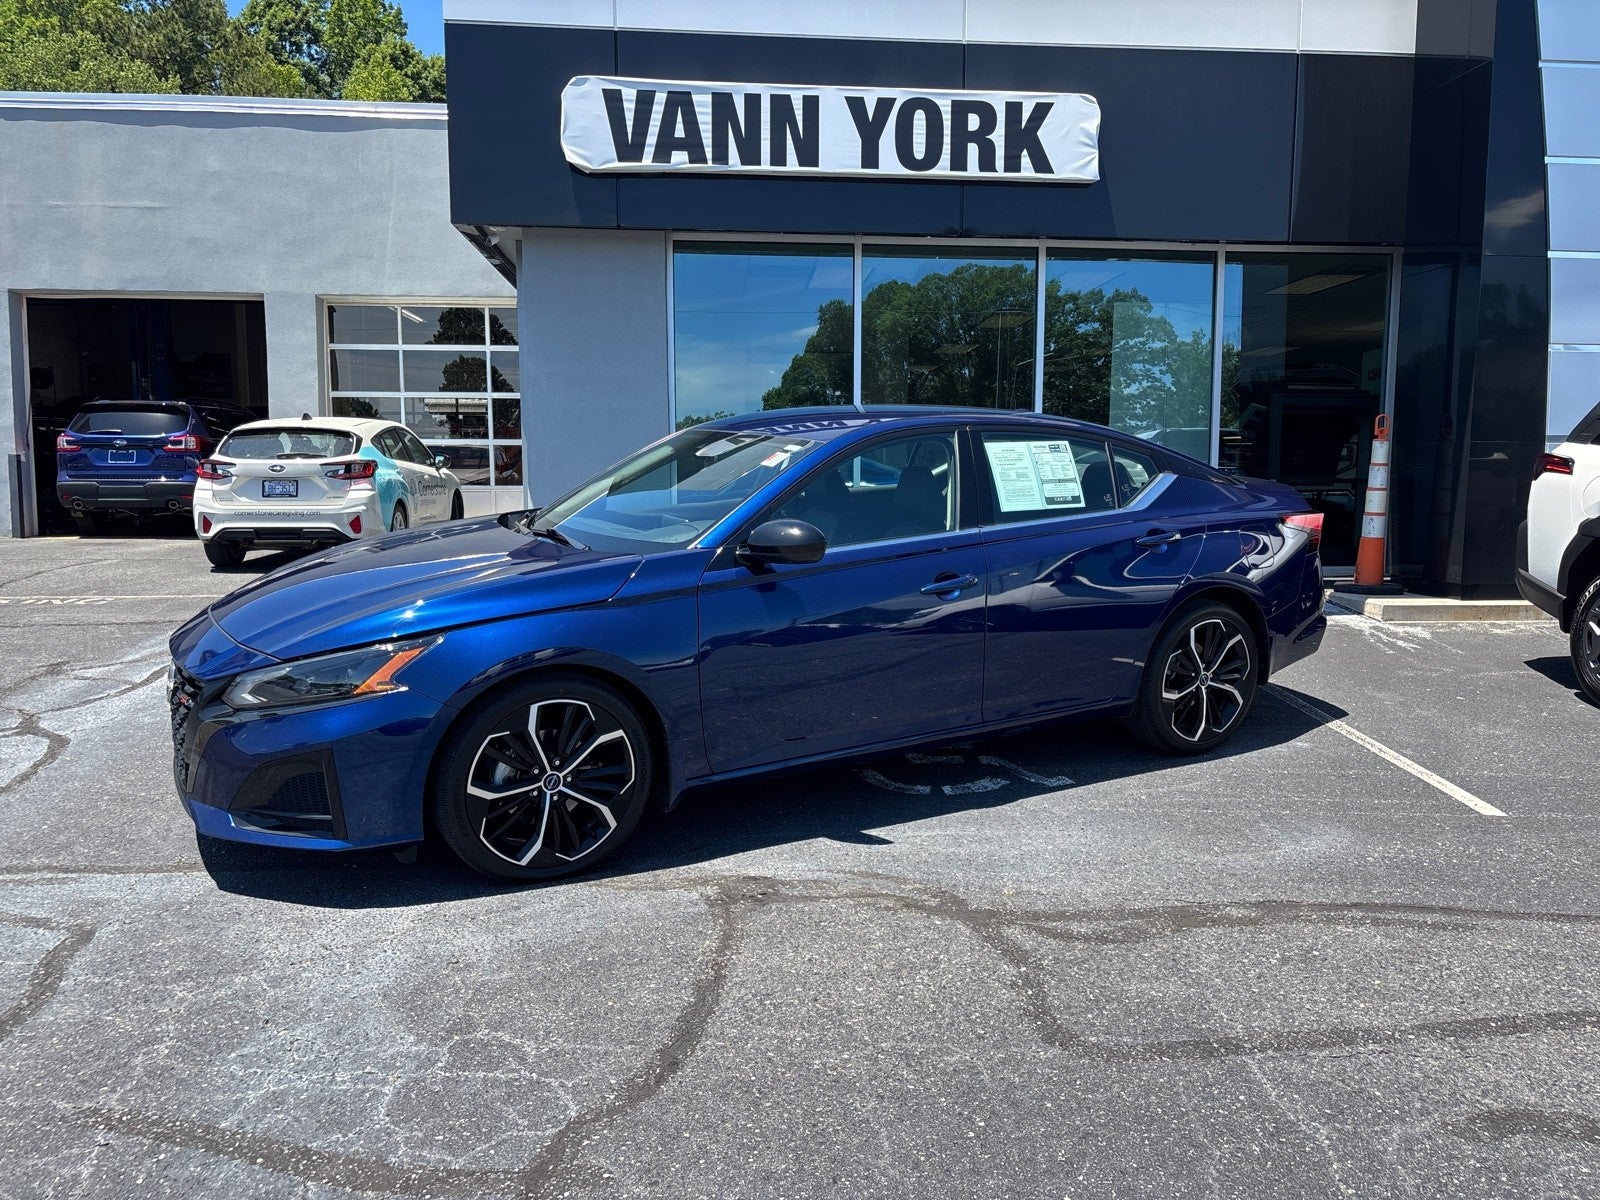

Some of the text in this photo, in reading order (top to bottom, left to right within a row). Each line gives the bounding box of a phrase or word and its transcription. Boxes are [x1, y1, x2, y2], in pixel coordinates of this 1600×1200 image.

[601, 88, 1056, 175] VANN YORK
[234, 509, 321, 517] cornerstonecaregiving.com
